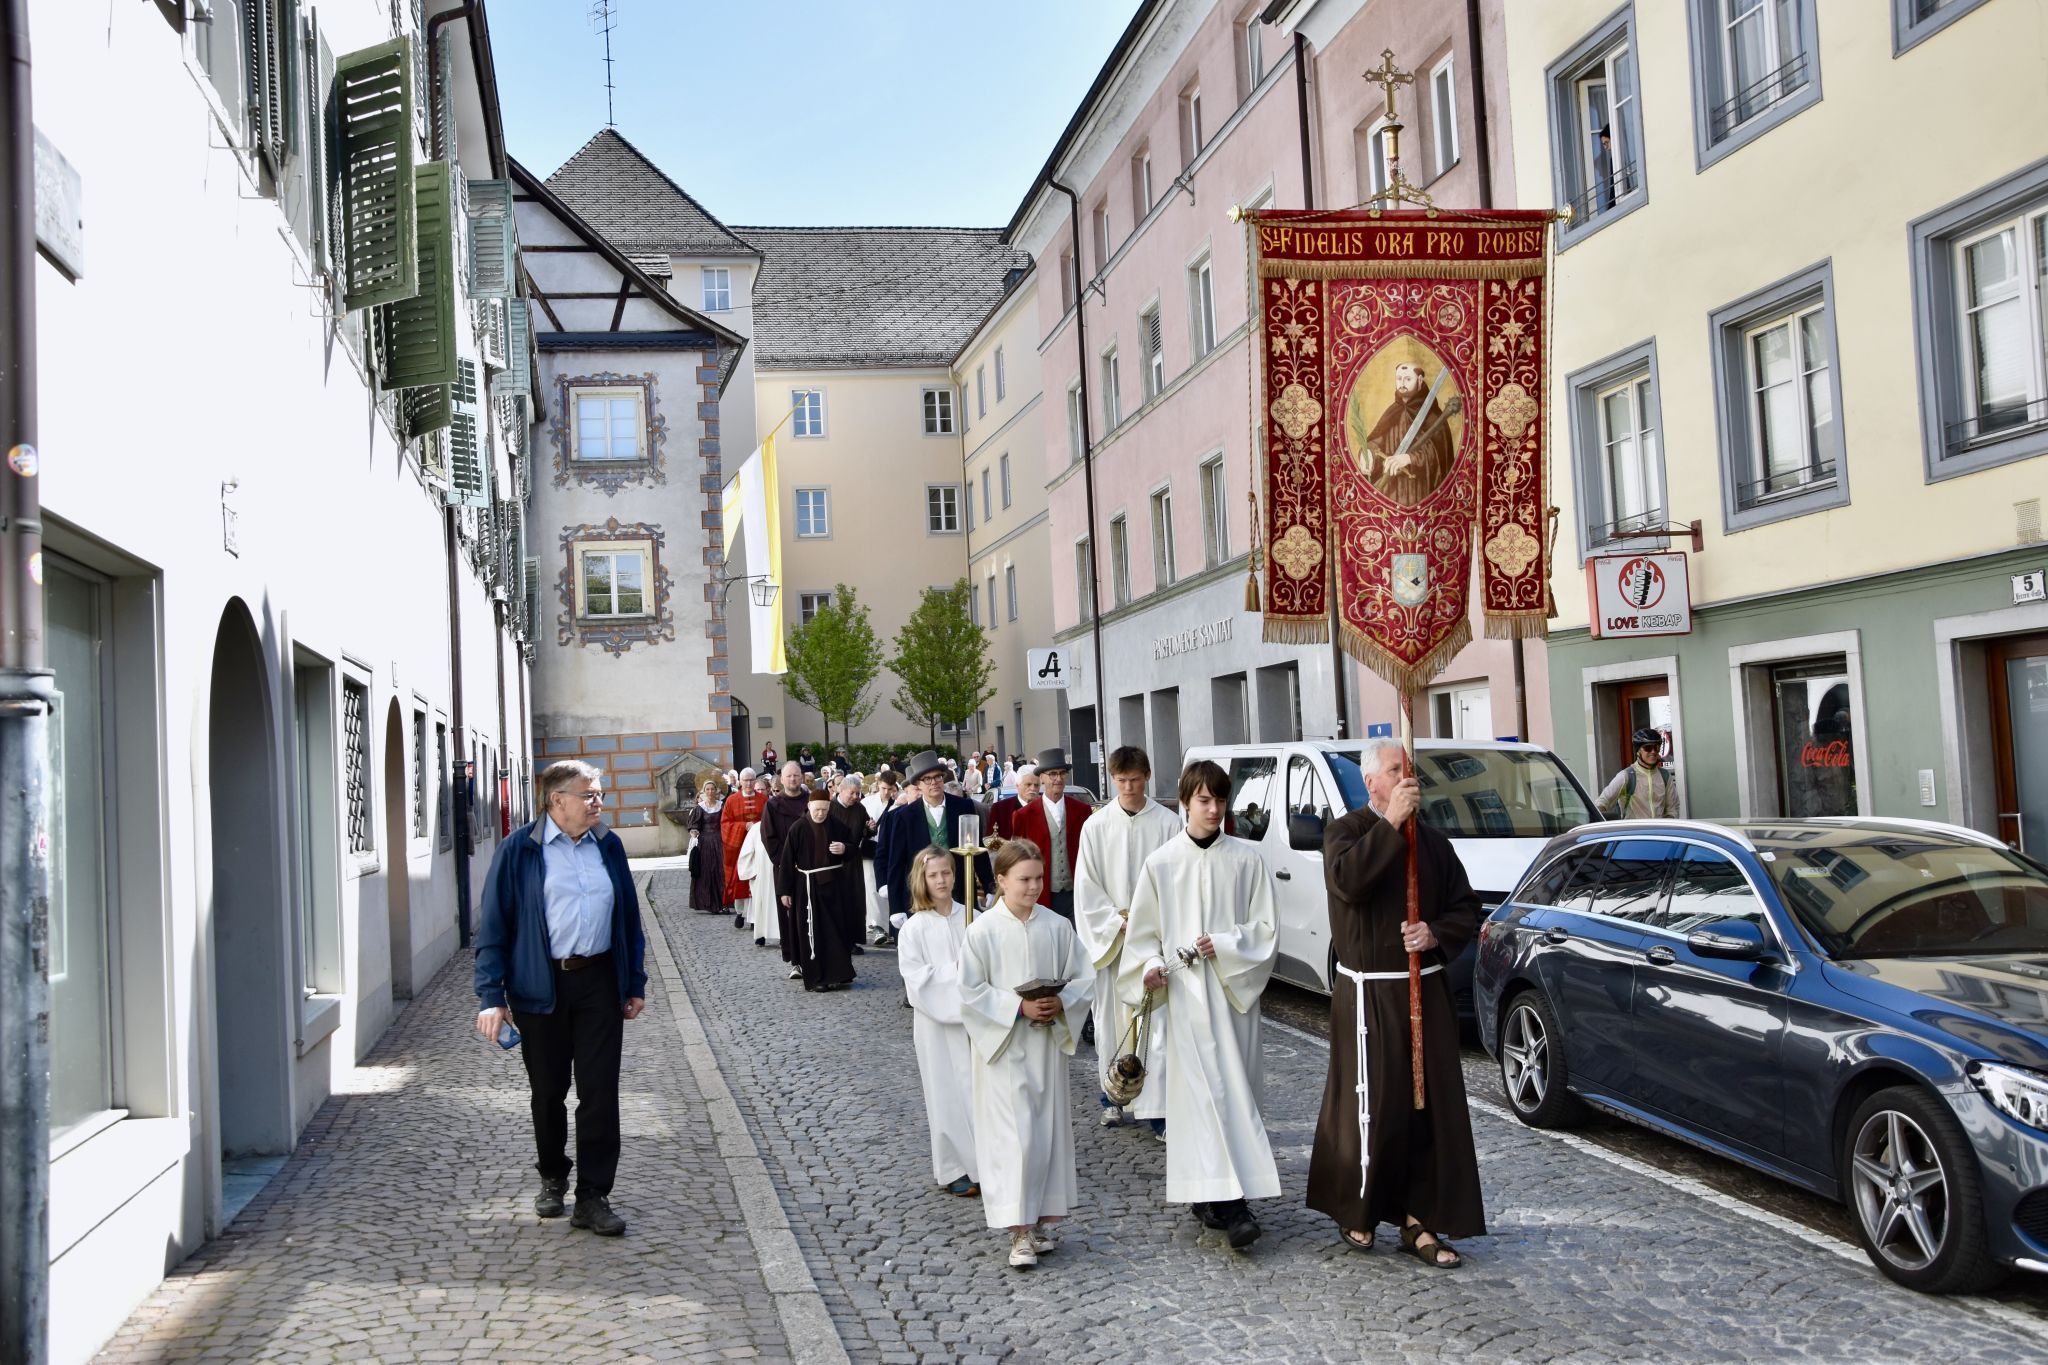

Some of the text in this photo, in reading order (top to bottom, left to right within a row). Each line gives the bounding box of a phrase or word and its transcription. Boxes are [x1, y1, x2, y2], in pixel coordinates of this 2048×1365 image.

[1375, 232, 1415, 256] ORA
[1426, 231, 1465, 257] PRO
[1478, 230, 1541, 254] NOBIS!
[2023, 575, 2034, 591] 5
[1607, 613, 1682, 630] LOVE KEBAP
[1801, 739, 1850, 768] Coca-Cola
